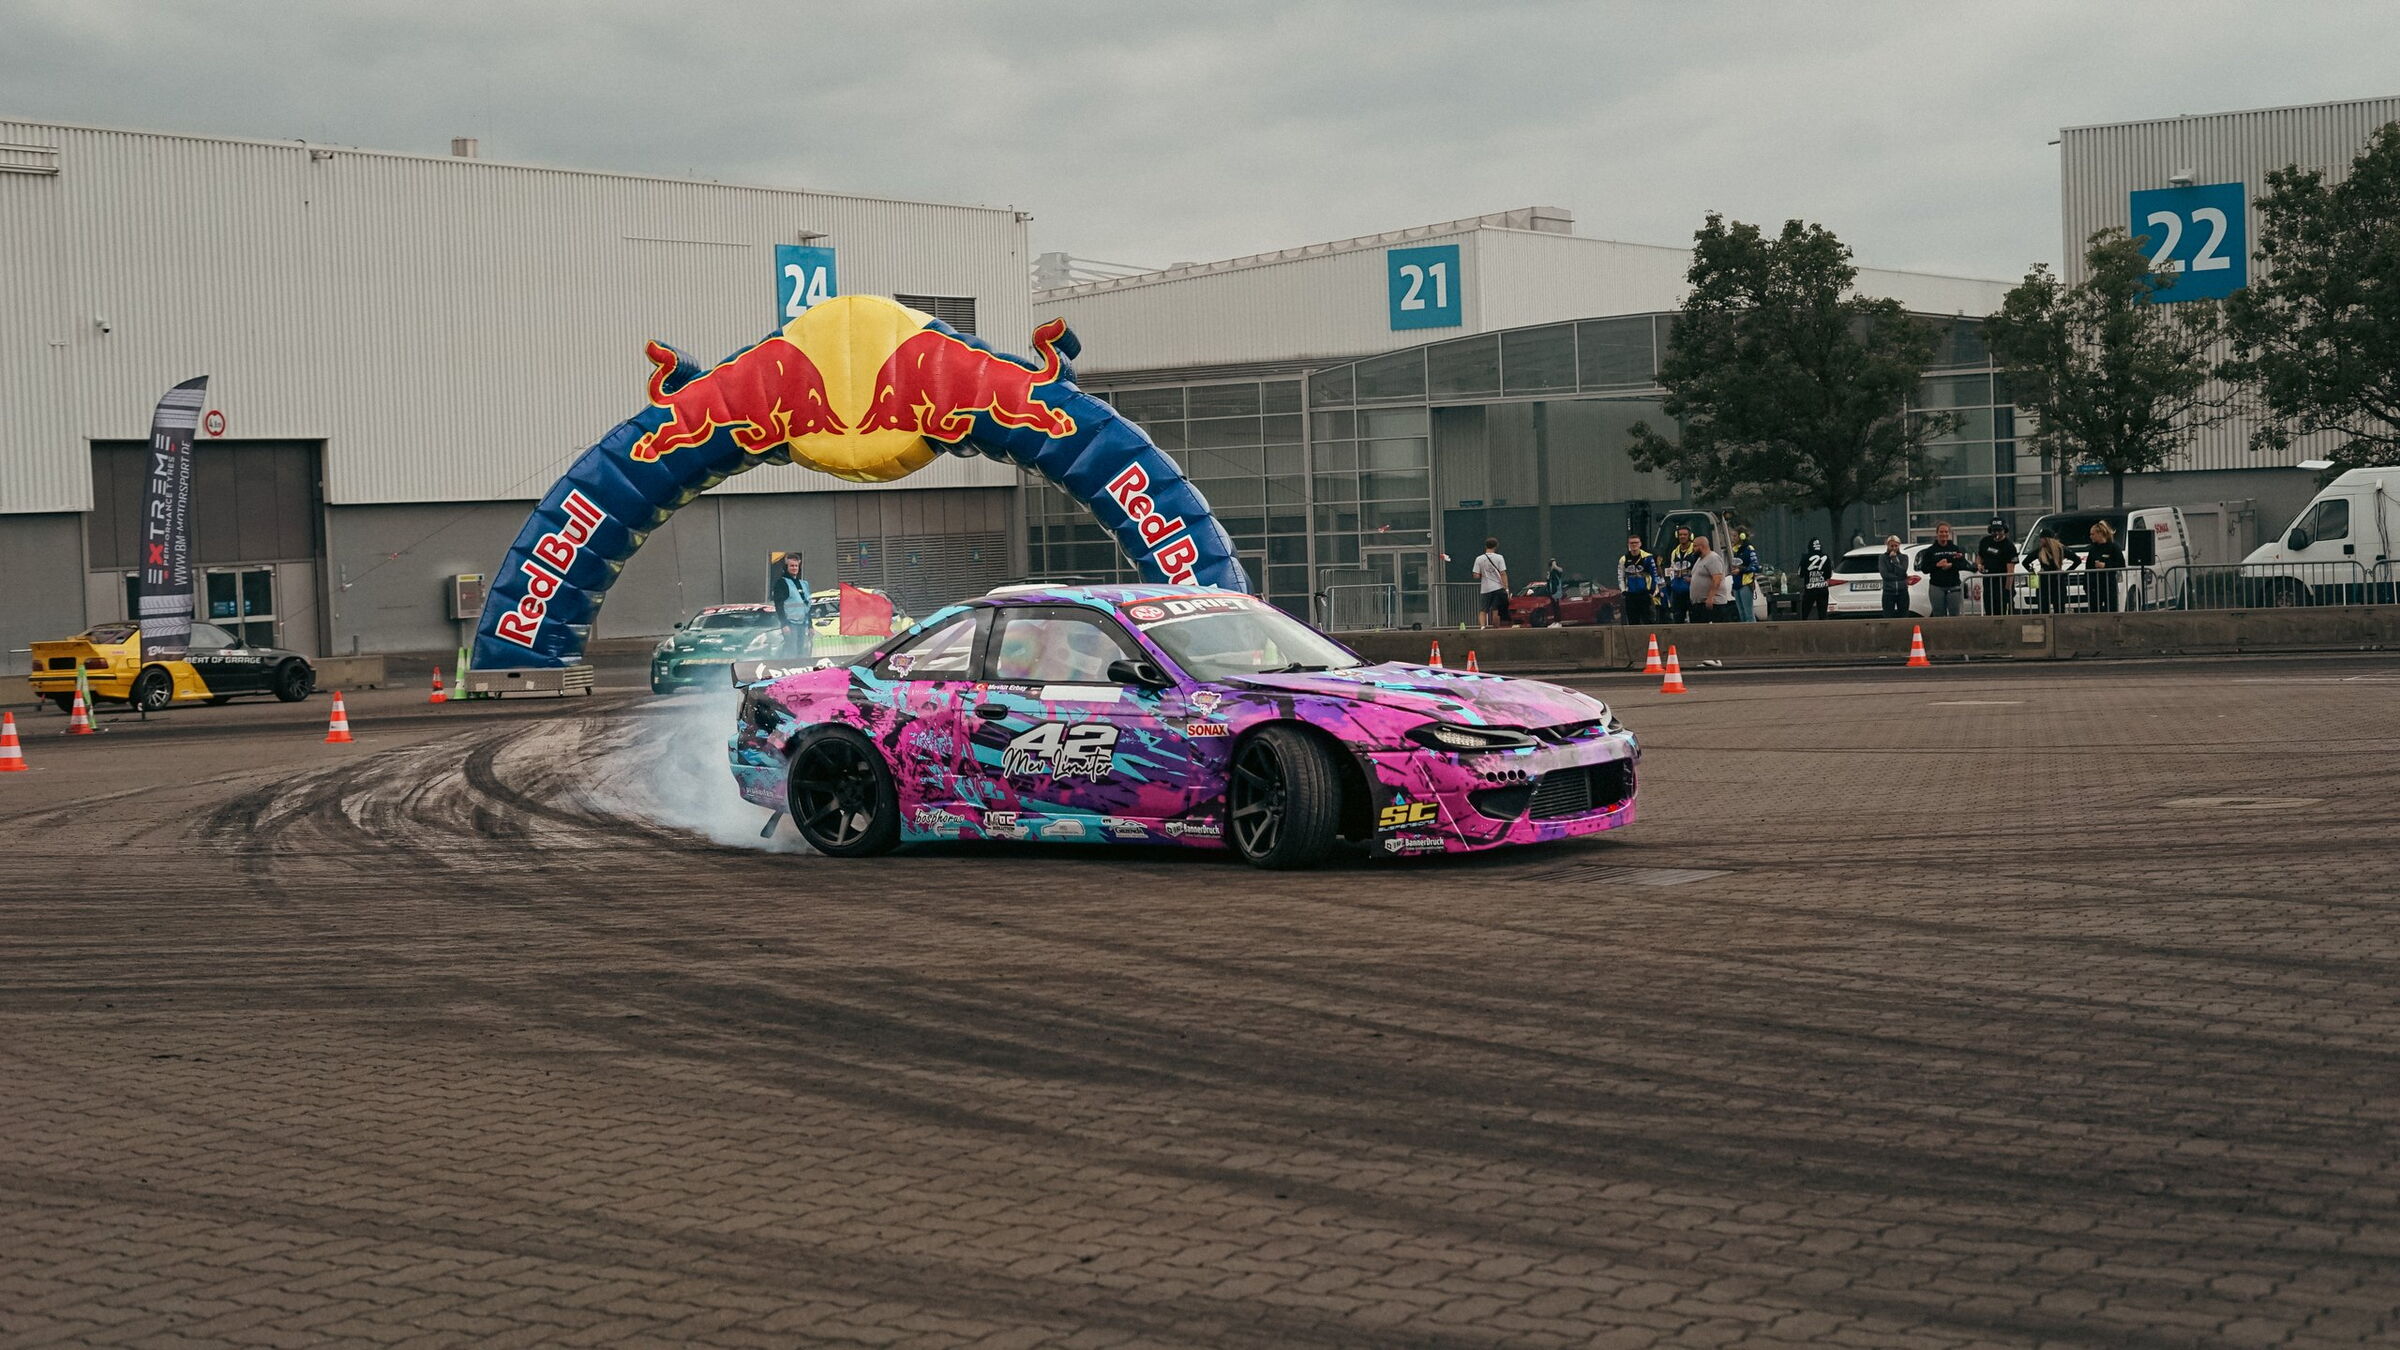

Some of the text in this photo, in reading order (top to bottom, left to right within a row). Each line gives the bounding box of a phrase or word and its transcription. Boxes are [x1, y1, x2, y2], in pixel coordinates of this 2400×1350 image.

[2147, 207, 2230, 273] 22
[784, 263, 832, 318] 24
[1400, 262, 1447, 310] 21
[148, 433, 170, 584] EXTREME
[163, 456, 175, 566] PERFORMANCE TYRES
[1105, 461, 1186, 548] Red
[495, 488, 607, 648] Red Bull
[1807, 554, 1828, 571] 21
[1164, 598, 1250, 615] DRIFT
[211, 656, 224, 664] OF
[225, 656, 261, 664] GARAGE
[1009, 722, 1119, 759] 42
[1188, 724, 1228, 736] SONAX
[1051, 746, 1114, 783] Limiter
[1405, 837, 1445, 847] BannerDruck
